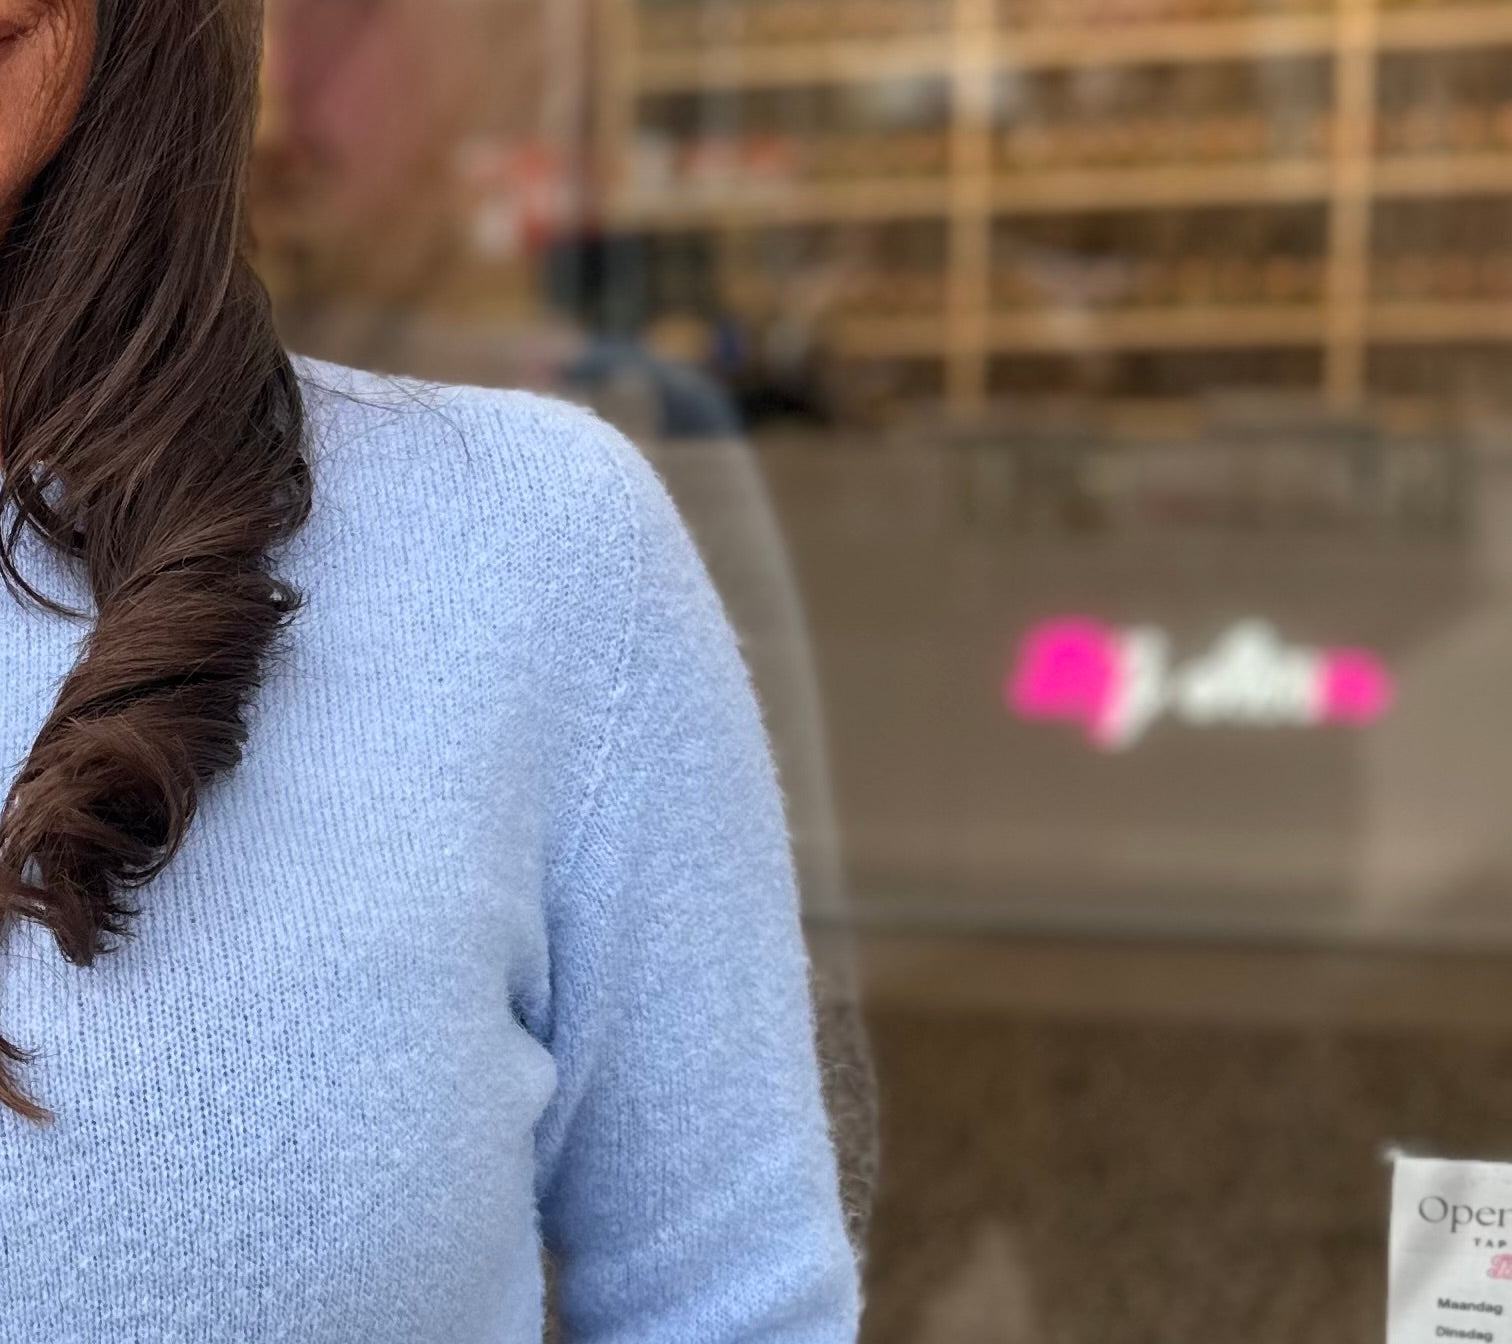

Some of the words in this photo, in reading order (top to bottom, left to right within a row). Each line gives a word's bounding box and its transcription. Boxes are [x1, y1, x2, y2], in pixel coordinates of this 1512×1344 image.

[1474, 1237, 1507, 1249] TAP
[1437, 1298, 1503, 1316] Maandag
[1436, 1326, 1493, 1344] Dinsdag
